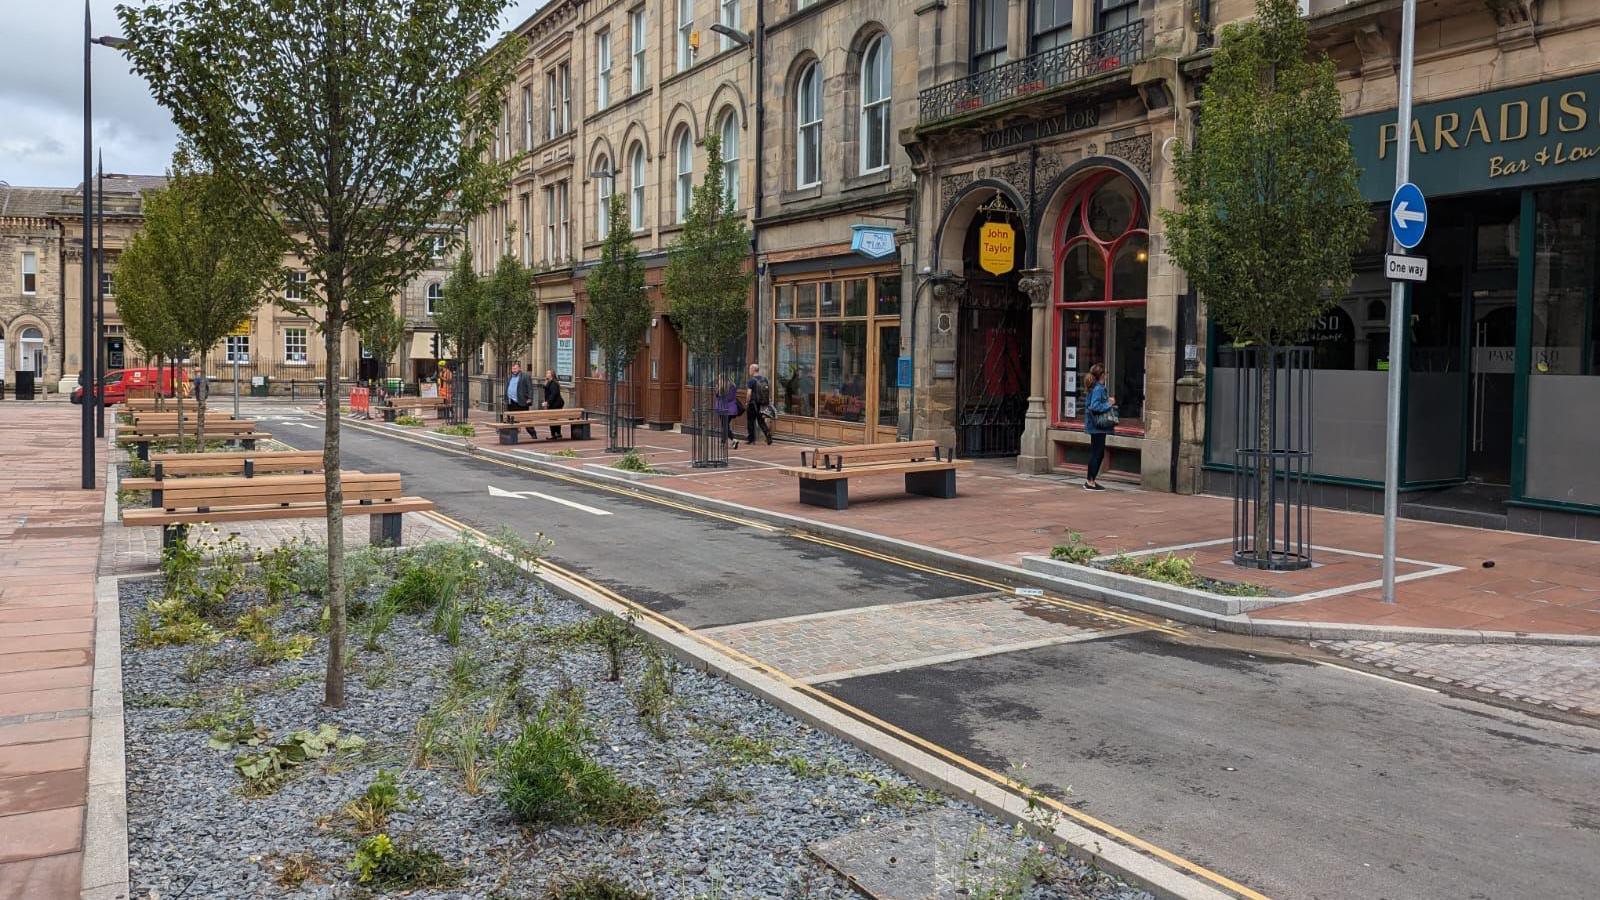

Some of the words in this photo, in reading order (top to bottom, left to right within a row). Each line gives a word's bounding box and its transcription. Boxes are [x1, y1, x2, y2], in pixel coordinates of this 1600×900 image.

[984, 125, 1024, 151] JOHN
[1034, 107, 1096, 138] TAYLOR
[1378, 90, 1600, 160] PARADIS
[1489, 155, 1530, 178] Bar
[1554, 142, 1600, 165] Lou
[987, 228, 1009, 238] John
[983, 242, 1012, 255] Taylor
[1390, 260, 1406, 273] One
[1408, 264, 1424, 277] way
